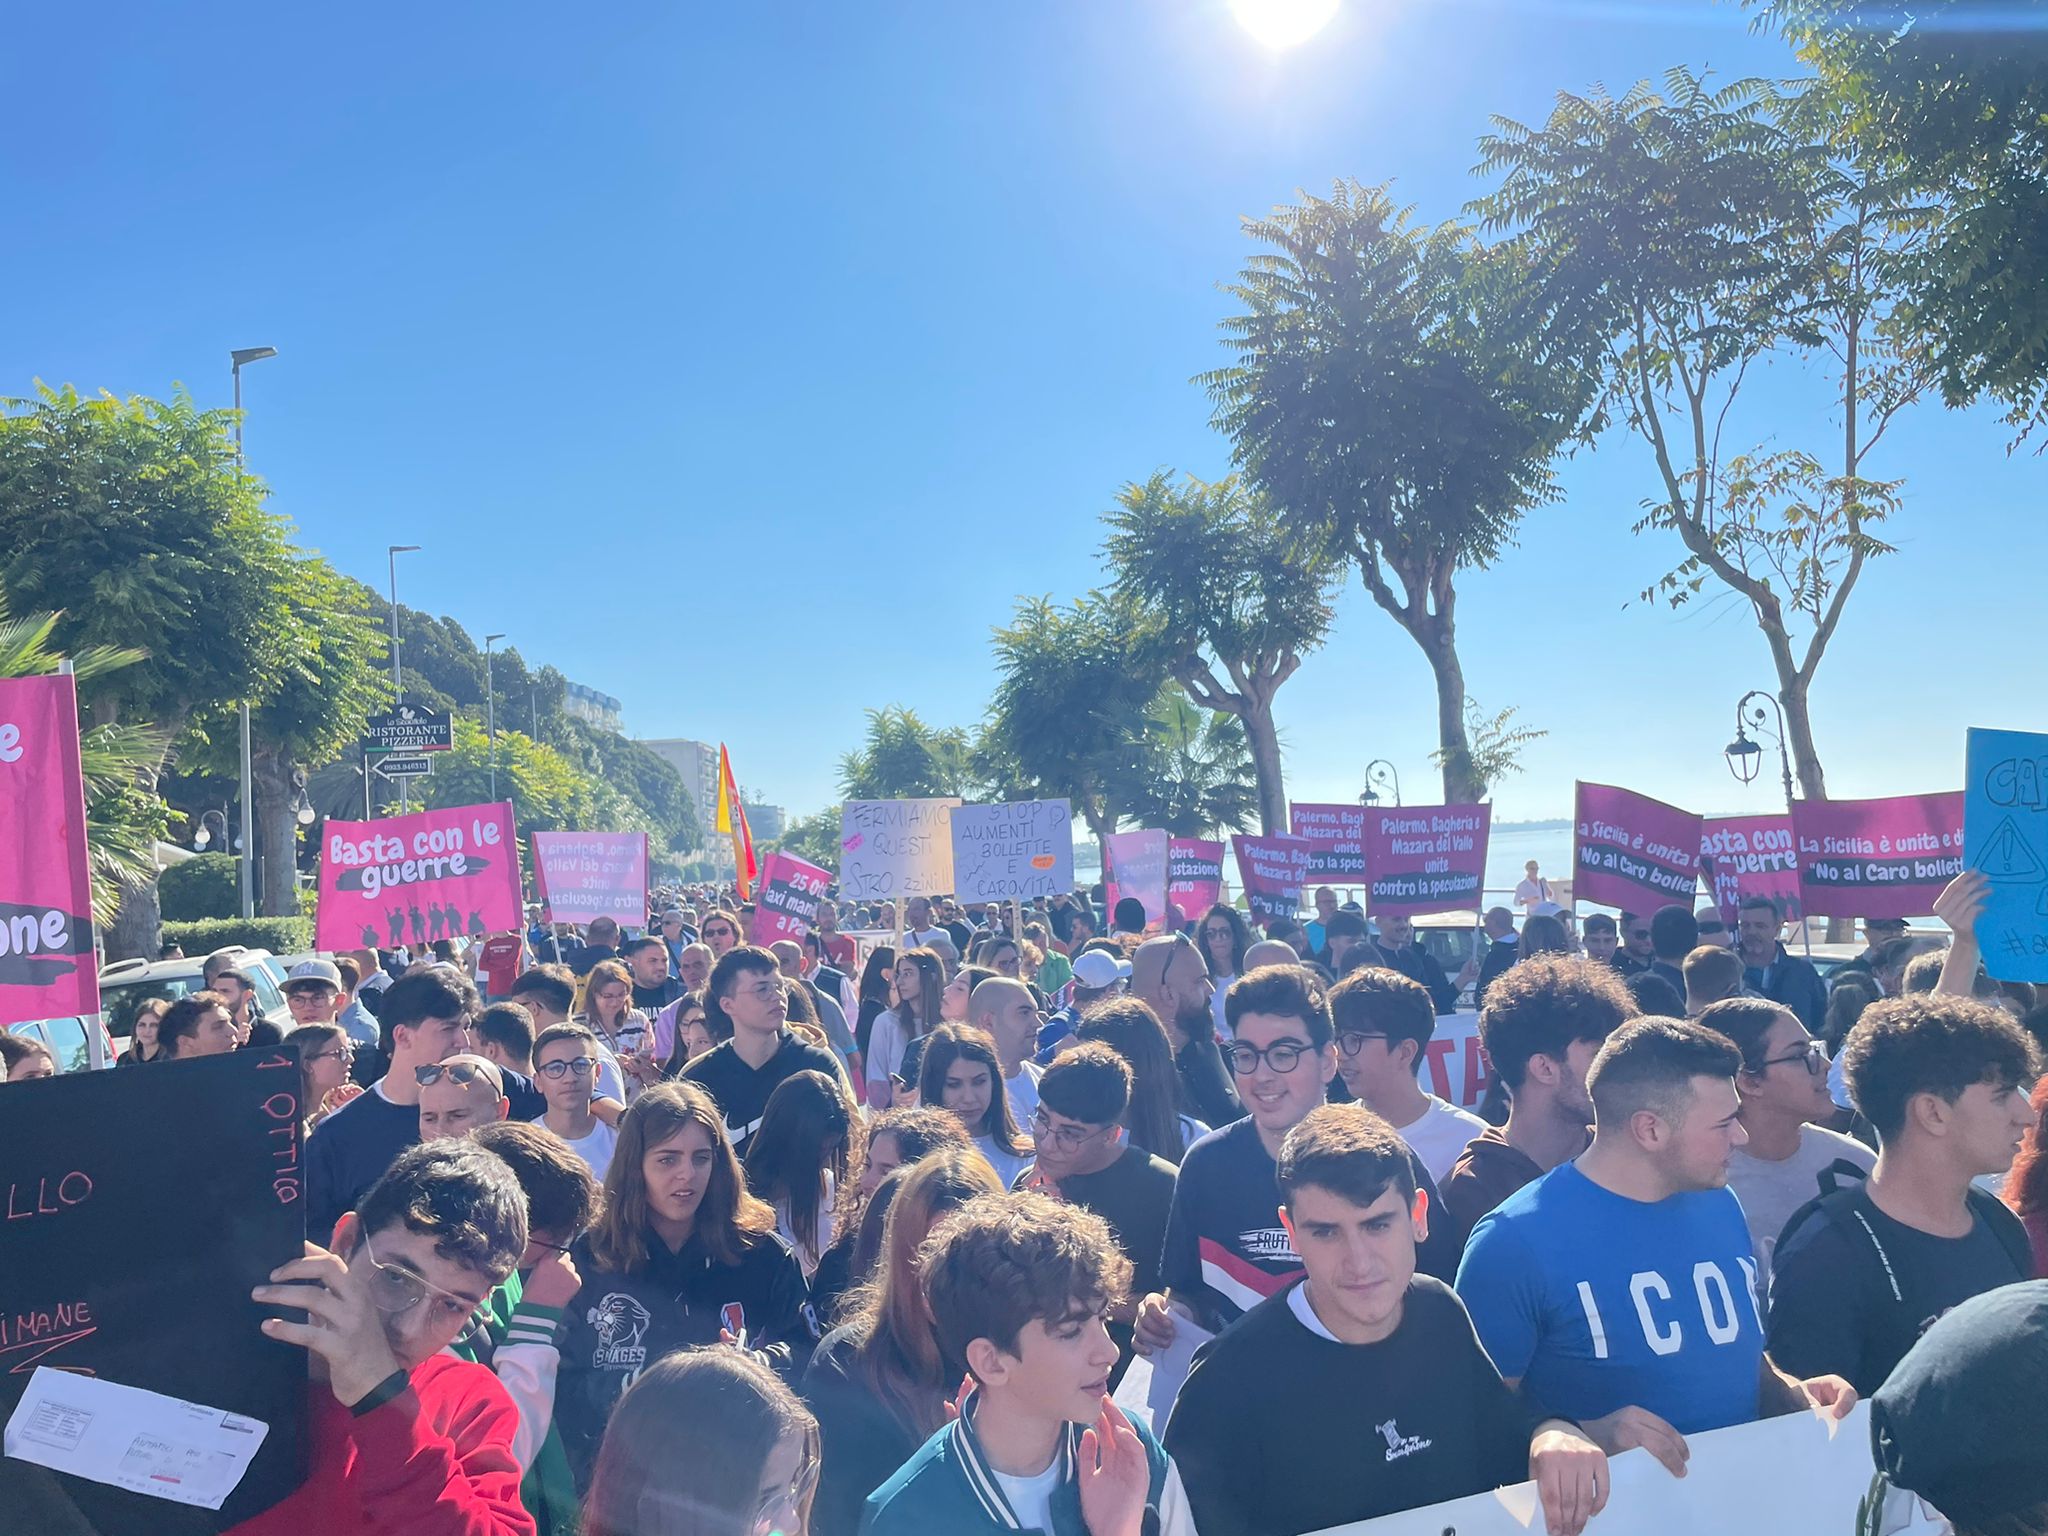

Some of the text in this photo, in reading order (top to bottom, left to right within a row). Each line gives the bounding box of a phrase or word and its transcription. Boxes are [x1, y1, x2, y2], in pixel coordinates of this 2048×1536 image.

[368, 725, 447, 737] RISTORANTE
[381, 735, 437, 747] PIZZERIA
[853, 804, 950, 829] FERMIAMO
[988, 802, 1042, 821] STOP
[1302, 825, 1361, 840] Mazara del
[1431, 815, 1473, 837] Bagheria
[330, 819, 501, 865] Basta con le
[1334, 841, 1361, 854] unite
[1391, 834, 1473, 855] Mazara del Vallo
[1592, 820, 1629, 847] Sicilia
[1631, 833, 1644, 849] è
[1646, 842, 1690, 867] unita
[1752, 828, 1792, 851] con
[1799, 836, 1820, 853] La
[1823, 836, 1875, 854] Sicilia
[1879, 835, 1891, 853] è
[1896, 832, 1939, 851] unita
[1942, 835, 1951, 847] e
[1007, 859, 1018, 874] E
[1327, 855, 1338, 869] la
[1424, 856, 1449, 874] unite
[1603, 852, 1617, 869] al
[1620, 856, 1647, 880] Caro
[361, 852, 468, 900] guerre
[789, 872, 809, 891] 25
[1843, 863, 1860, 881] al
[1865, 863, 1909, 881] Caro
[977, 876, 1057, 897] CAROVITA
[1372, 878, 1416, 896] contro
[1418, 877, 1428, 894] la
[776, 916, 787, 930] a
[7, 1171, 93, 1219] LLO
[1256, 1230, 1290, 1250] FRUT
